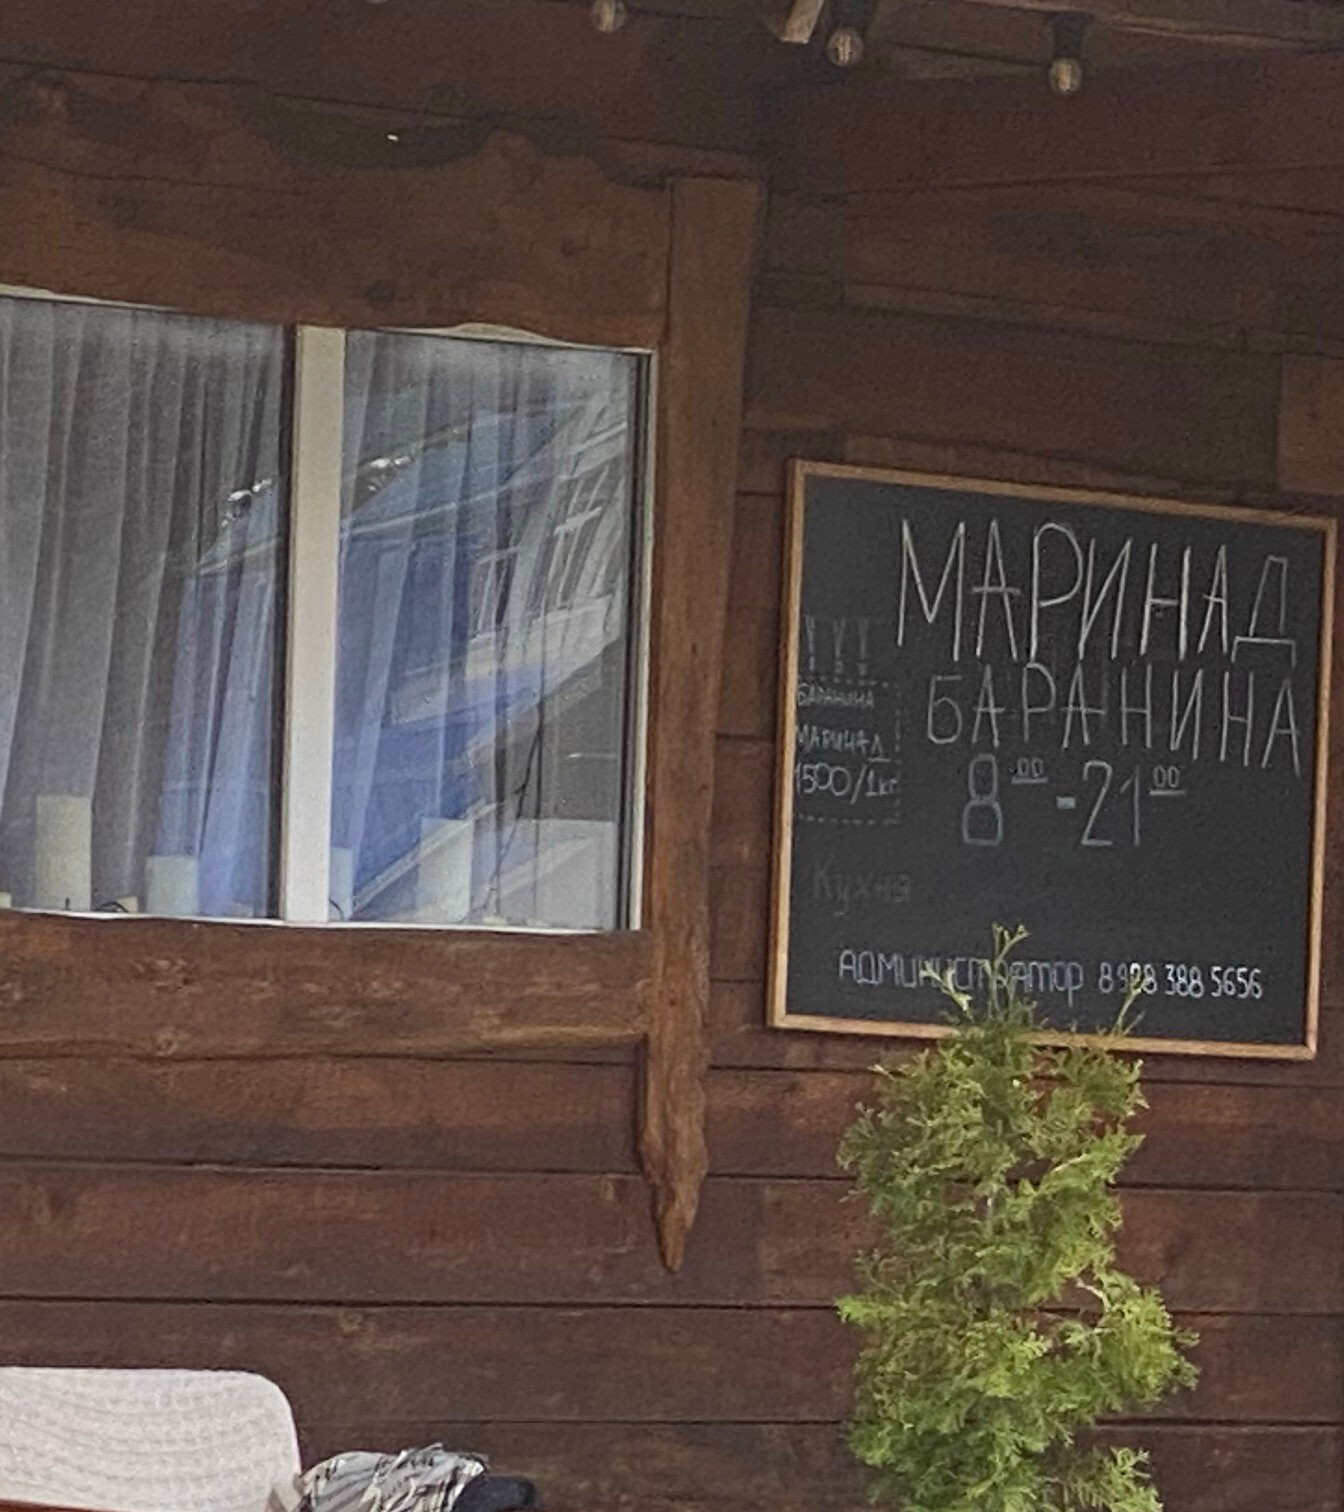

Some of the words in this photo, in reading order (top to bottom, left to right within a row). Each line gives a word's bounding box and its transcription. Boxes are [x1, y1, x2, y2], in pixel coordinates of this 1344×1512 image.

[896, 517, 1297, 668] МАРИНАД
[927, 661, 1303, 778] БАРАНИНА
[1165, 963, 1205, 999] 388
[1211, 965, 1264, 1000] 5656
